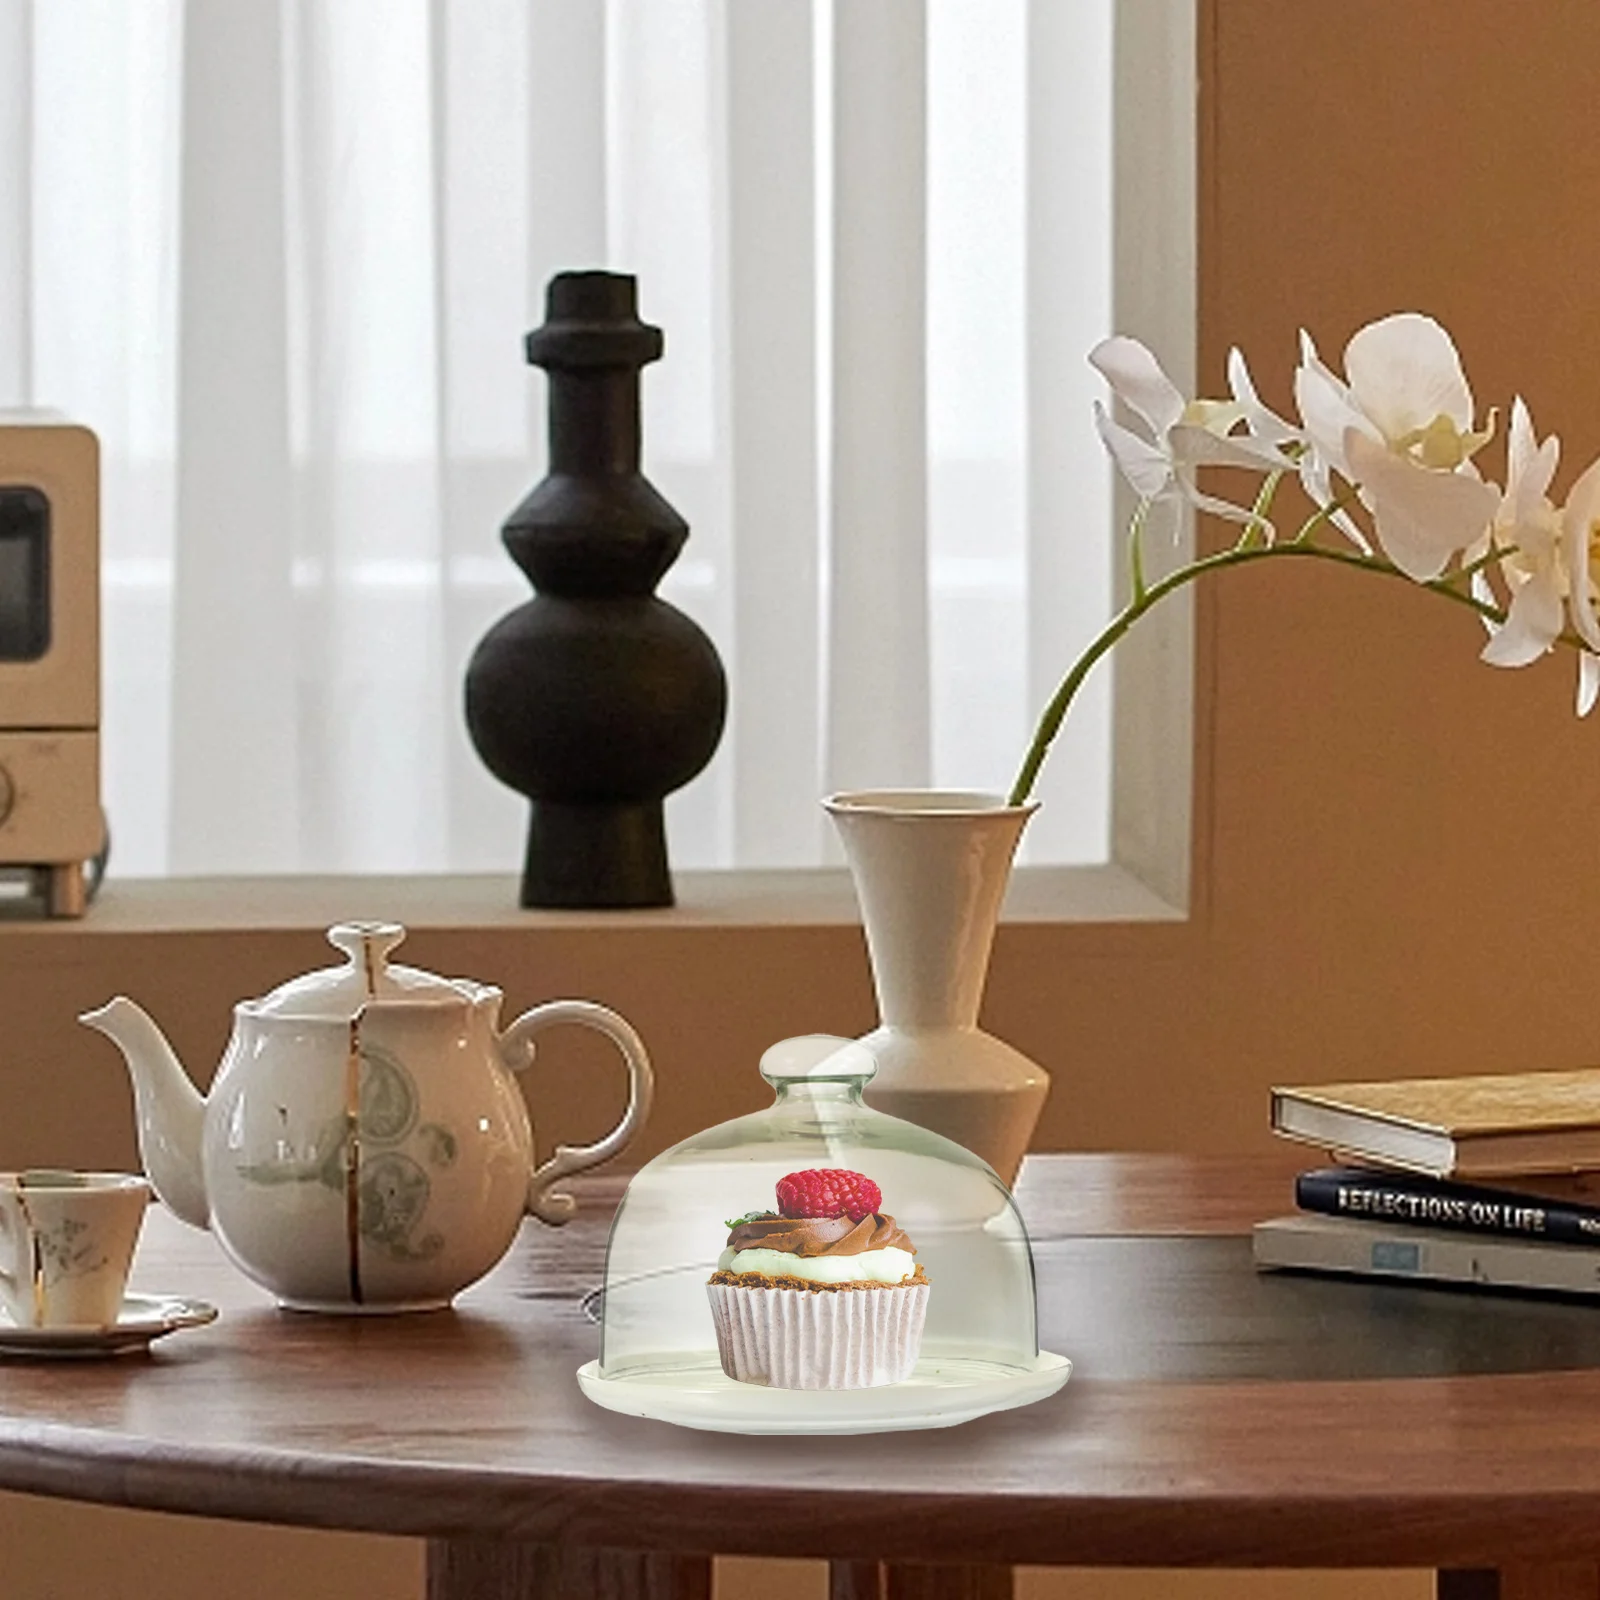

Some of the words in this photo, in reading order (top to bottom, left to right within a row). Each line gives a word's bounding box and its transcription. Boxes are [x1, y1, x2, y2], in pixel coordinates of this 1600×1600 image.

[1338, 1187, 1466, 1221] REFLECTIONS
[1470, 1201, 1499, 1225] ON
[1503, 1205, 1546, 1232] LIFE
